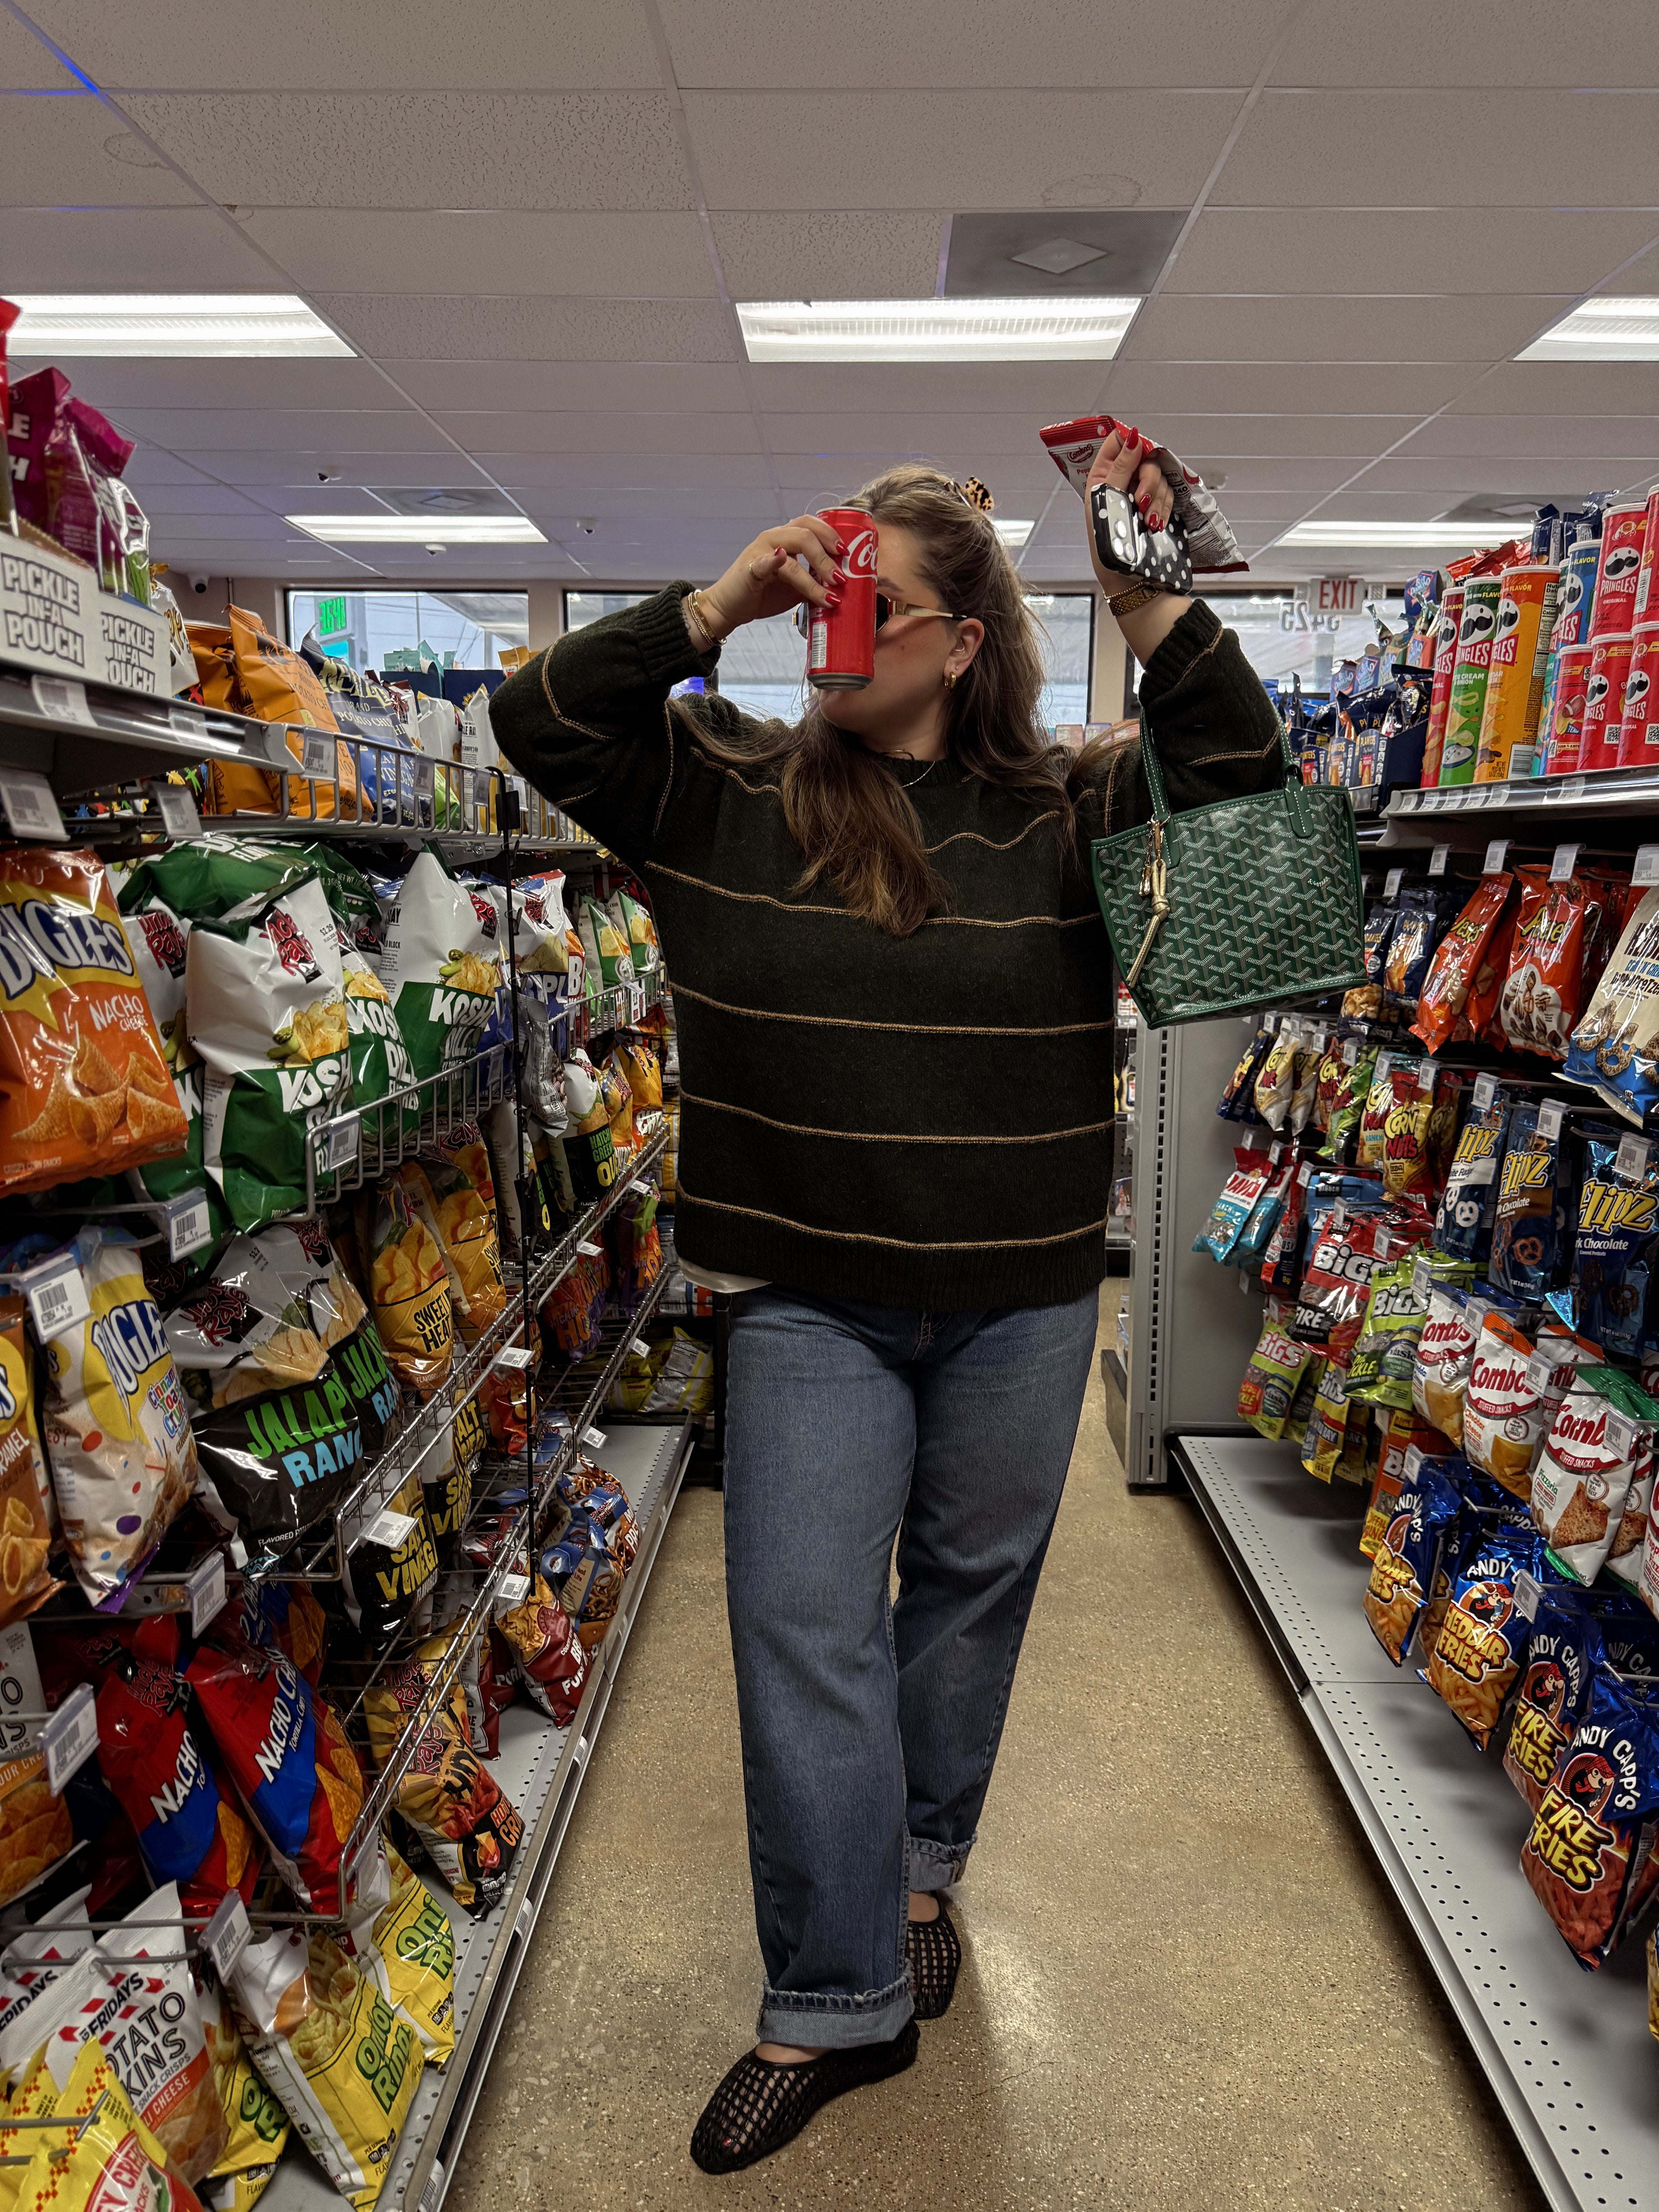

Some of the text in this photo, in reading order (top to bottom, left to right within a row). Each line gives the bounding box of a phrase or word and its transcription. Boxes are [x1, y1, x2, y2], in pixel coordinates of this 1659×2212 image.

[1573, 556, 1595, 566] FLAVOR
[2, 553, 80, 615] PICKLE
[1319, 581, 1357, 609] EXIT
[1599, 576, 1637, 597] PRINGLES
[5, 609, 85, 667] POUCH
[101, 612, 154, 658] PICKLE
[108, 658, 156, 693] OUCH
[338, 711, 372, 727] POTATO
[1361, 735, 1376, 747] PLANTERS
[319, 923, 333, 936] $2.29
[90, 994, 143, 1031] NACHO
[429, 988, 495, 1027] KOSH
[119, 1015, 148, 1032] CHEESE
[277, 1050, 353, 1113] KOSH
[1385, 1106, 1420, 1139] CORN
[1365, 1134, 1382, 1142] RANCH
[1386, 1134, 1418, 1160] NUTS
[42, 1156, 61, 1168] SNACKS
[1503, 1197, 1530, 1212] Chocolate
[1575, 1238, 1629, 1250] rk Chocolate
[245, 1372, 349, 1459] JALAP
[1465, 1408, 1485, 1430] Cheddar
[1477, 1400, 1512, 1414] STUFFED SNACKS
[1465, 1420, 1481, 1440] Cheese
[1573, 1458, 1595, 1468] SNACKS
[1537, 1468, 1558, 1495] Pizzeria
[1467, 1558, 1511, 1578] ANDY
[1444, 1605, 1506, 1665] HEDDAR
[1529, 1634, 1560, 1662] ANDY
[1438, 1631, 1482, 1678] FRIES
[254, 1695, 292, 1784] NACHO
[1510, 1724, 1554, 1780] RIES
[0, 1764, 19, 1786] OUR
[149, 1729, 199, 1824] NACHO
[1570, 1725, 1615, 1750] ANDY
[1612, 1739, 1641, 1811] CAPP'S
[1539, 1789, 1610, 1854] FIRE
[89, 1972, 144, 2036] FRIDAYS
[159, 2053, 191, 2085] CRISPS
[153, 2072, 191, 2116] CHEESE
